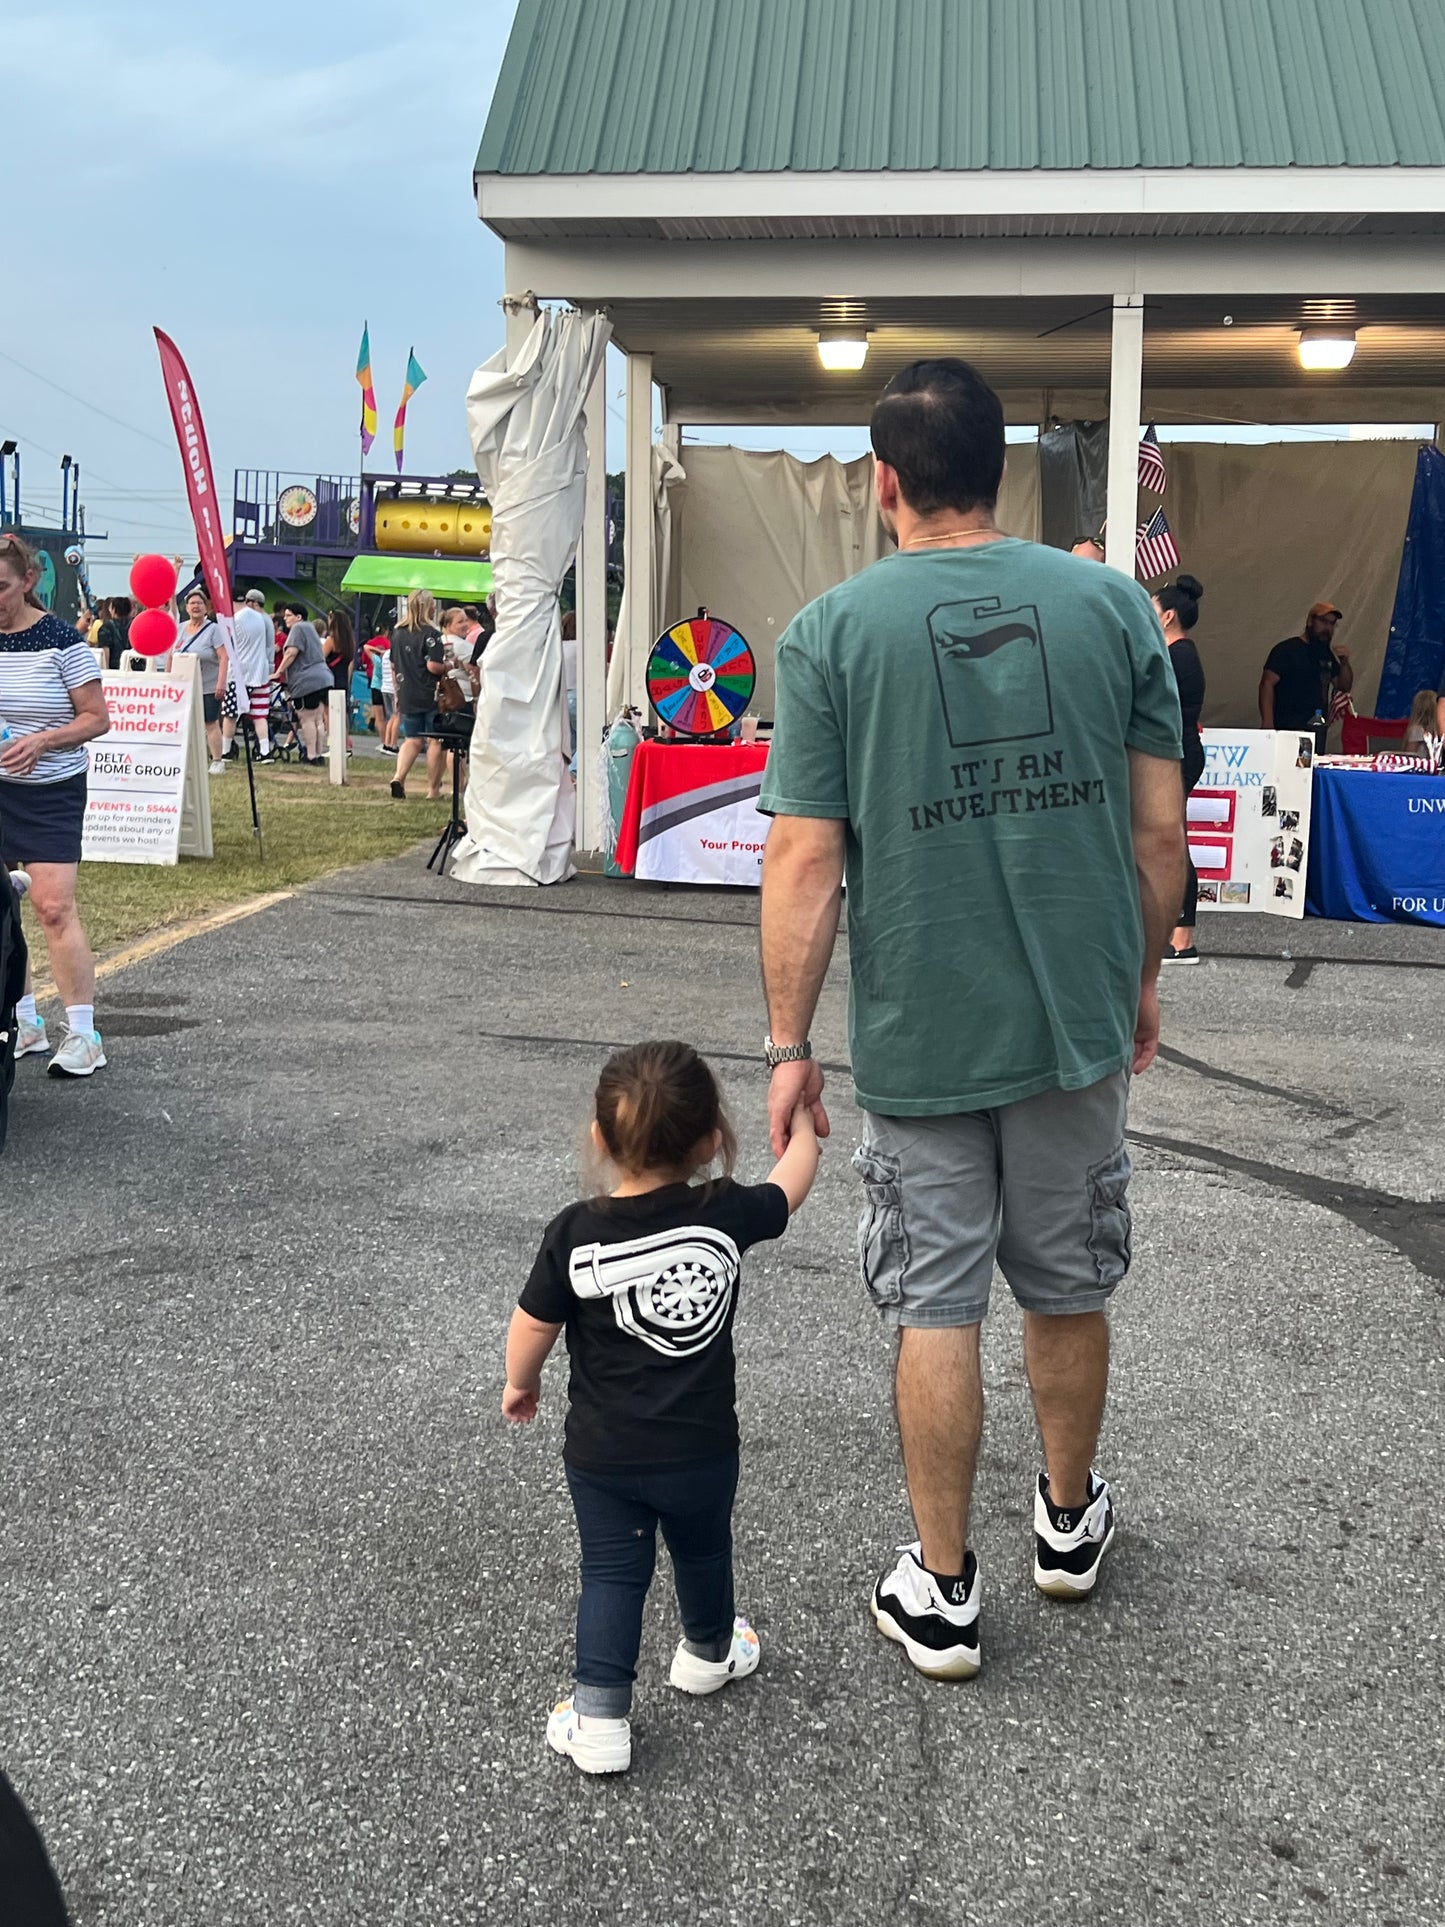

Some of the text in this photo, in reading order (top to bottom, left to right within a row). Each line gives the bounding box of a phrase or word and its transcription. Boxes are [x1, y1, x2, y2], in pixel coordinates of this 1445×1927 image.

[103, 685, 185, 702] mmunity
[106, 700, 155, 715] Event
[109, 716, 179, 733] minders!
[95, 752, 132, 763] DELTA
[1202, 744, 1250, 768] FW
[94, 763, 181, 777] HOME GROUP
[951, 750, 1064, 789] IT'S AN
[1199, 771, 1267, 787] ILIARY
[89, 801, 178, 814] EVENTS to 55444
[908, 779, 1107, 832] INVESTMENT
[98, 814, 111, 823] up
[112, 813, 125, 823] for
[126, 815, 172, 825] reminders
[118, 825, 145, 834] about
[146, 827, 164, 836] any
[164, 827, 175, 835] of
[91, 835, 121, 844] events
[700, 839, 728, 850] Your
[1392, 897, 1428, 912] FOR
[1056, 1513, 1072, 1531] 45
[951, 1581, 966, 1601] 45
